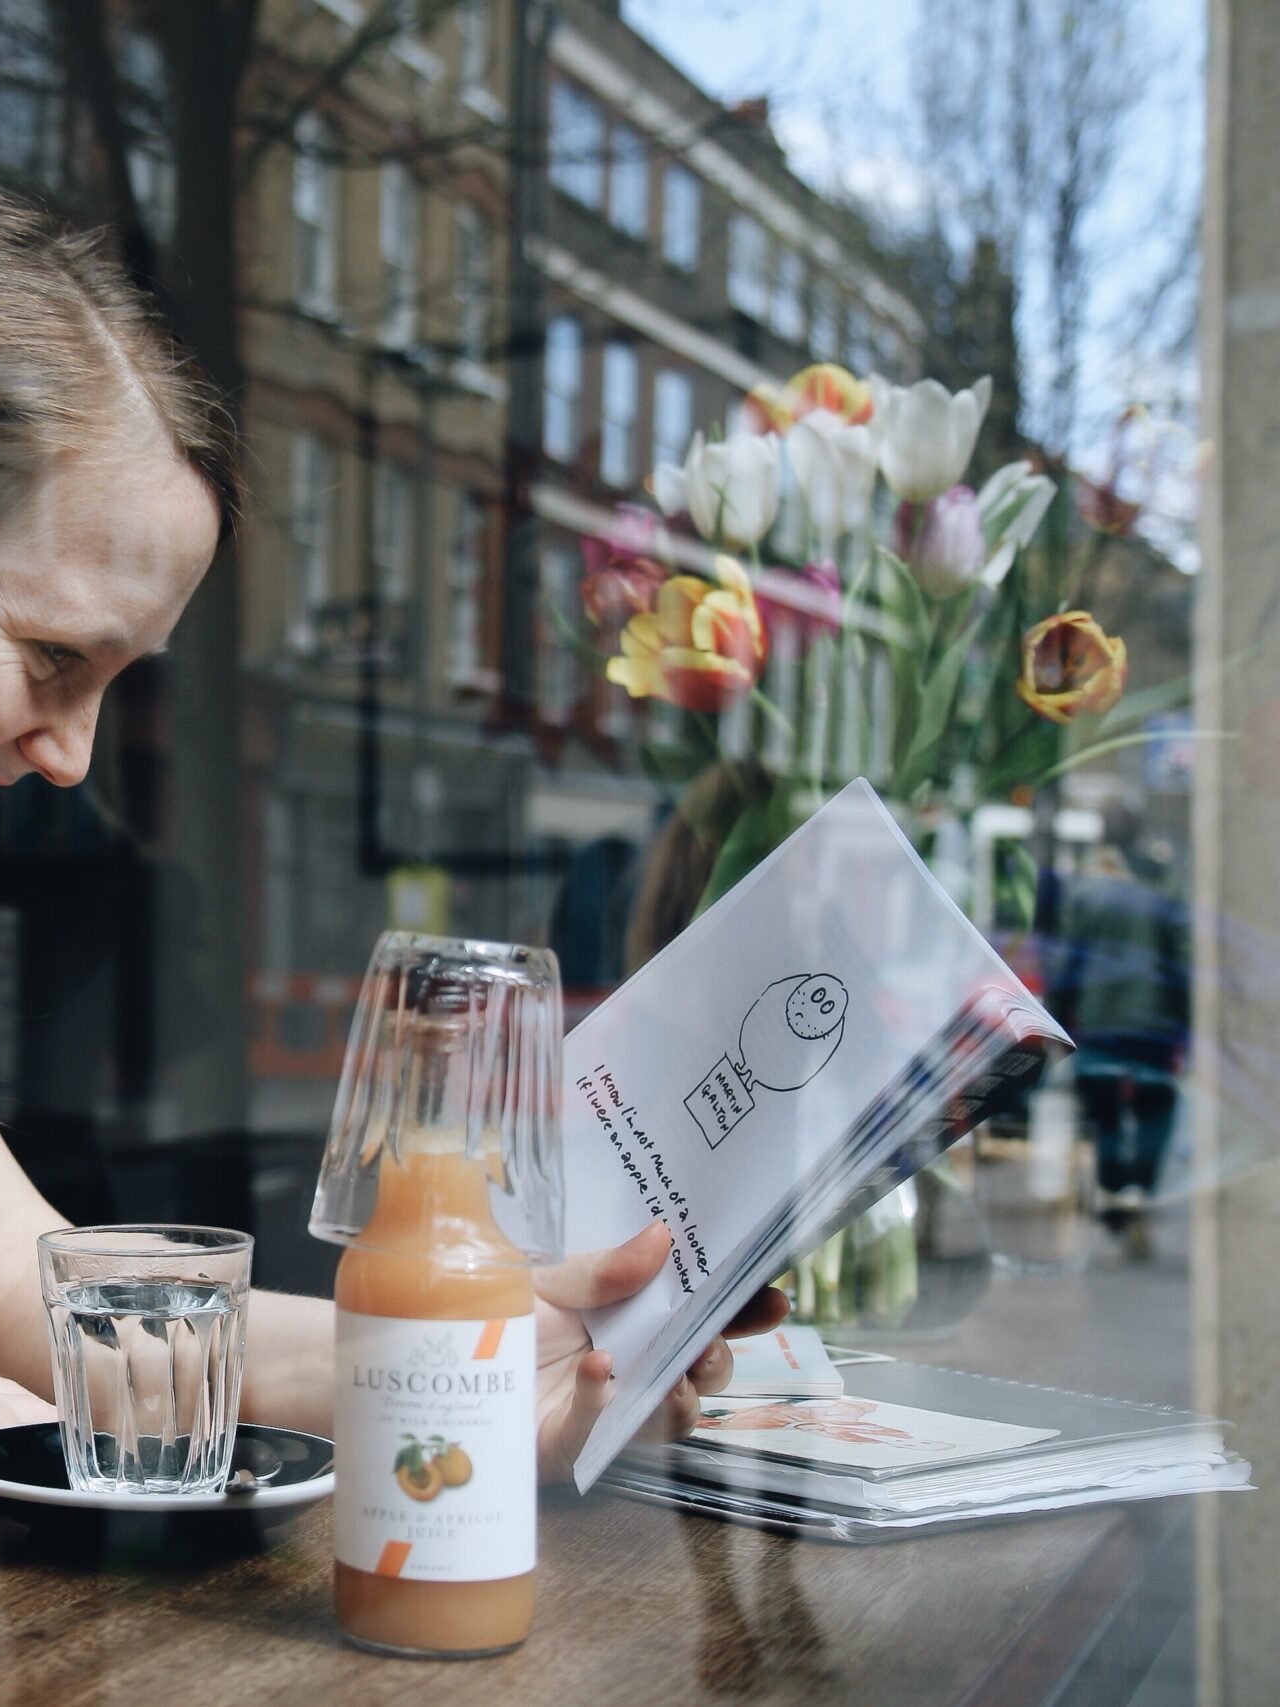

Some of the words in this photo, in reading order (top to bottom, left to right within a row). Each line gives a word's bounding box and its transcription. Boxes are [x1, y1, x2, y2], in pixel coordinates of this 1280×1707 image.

[594, 1064, 605, 1073] I
[576, 1076, 593, 1091] If
[714, 1072, 743, 1114] MARTIN
[586, 1090, 598, 1099] I
[591, 1098, 613, 1131] were
[701, 1083, 729, 1131] GALTON
[610, 1131, 623, 1152] an
[633, 1130, 655, 1150] not
[621, 1151, 648, 1195] apple
[645, 1195, 664, 1217] I'd
[669, 1192, 686, 1205] of
[679, 1207, 689, 1223] a
[683, 1224, 710, 1276] looker
[672, 1248, 694, 1294] cooker
[352, 1364, 515, 1396] LUSCOMBE
[362, 1505, 407, 1522] APPLE
[406, 1526, 456, 1539] JUICE
